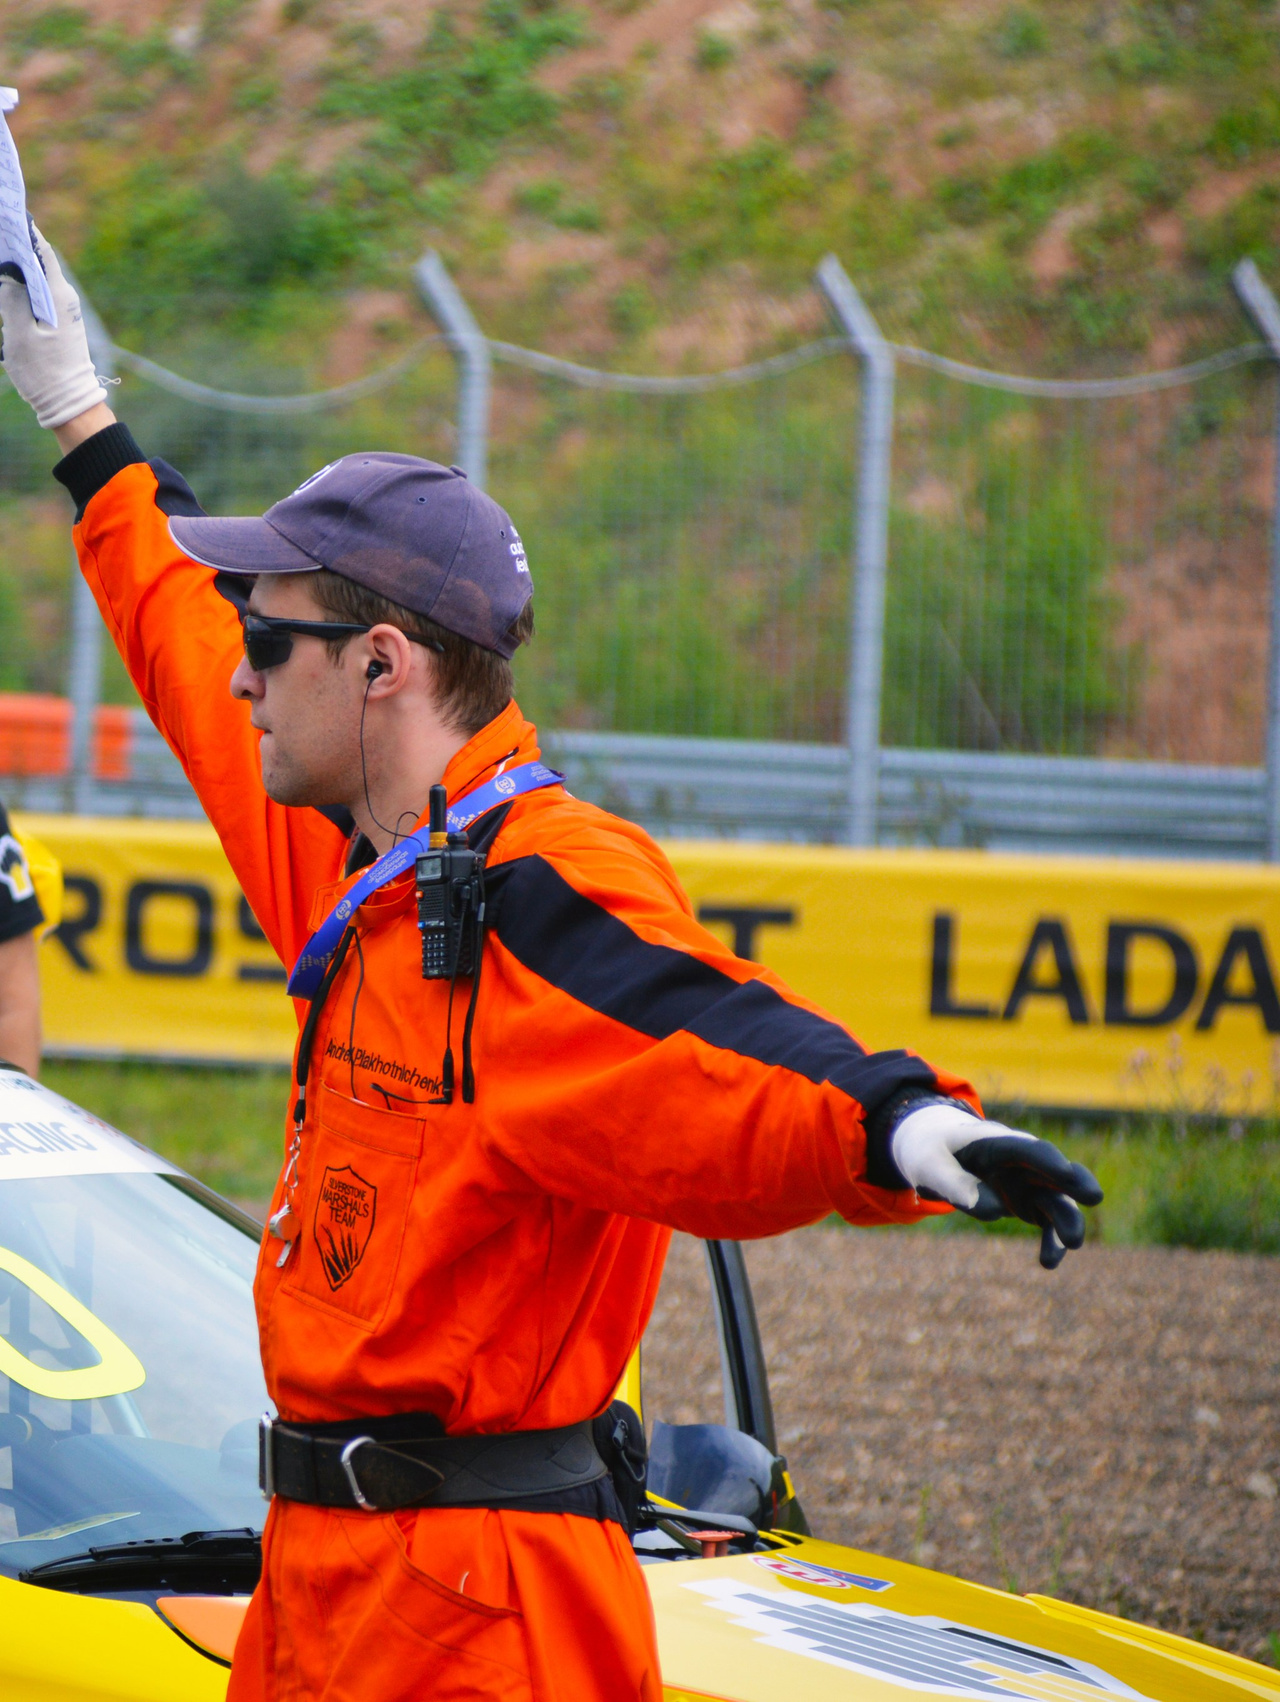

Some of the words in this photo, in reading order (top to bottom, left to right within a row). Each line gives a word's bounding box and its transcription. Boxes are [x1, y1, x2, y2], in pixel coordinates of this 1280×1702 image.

[929, 911, 1280, 1034] LADA
[354, 1048, 447, 1095] Plakhotnichenk
[322, 1187, 369, 1218] MARSHALS
[329, 1205, 356, 1229] TEAM
